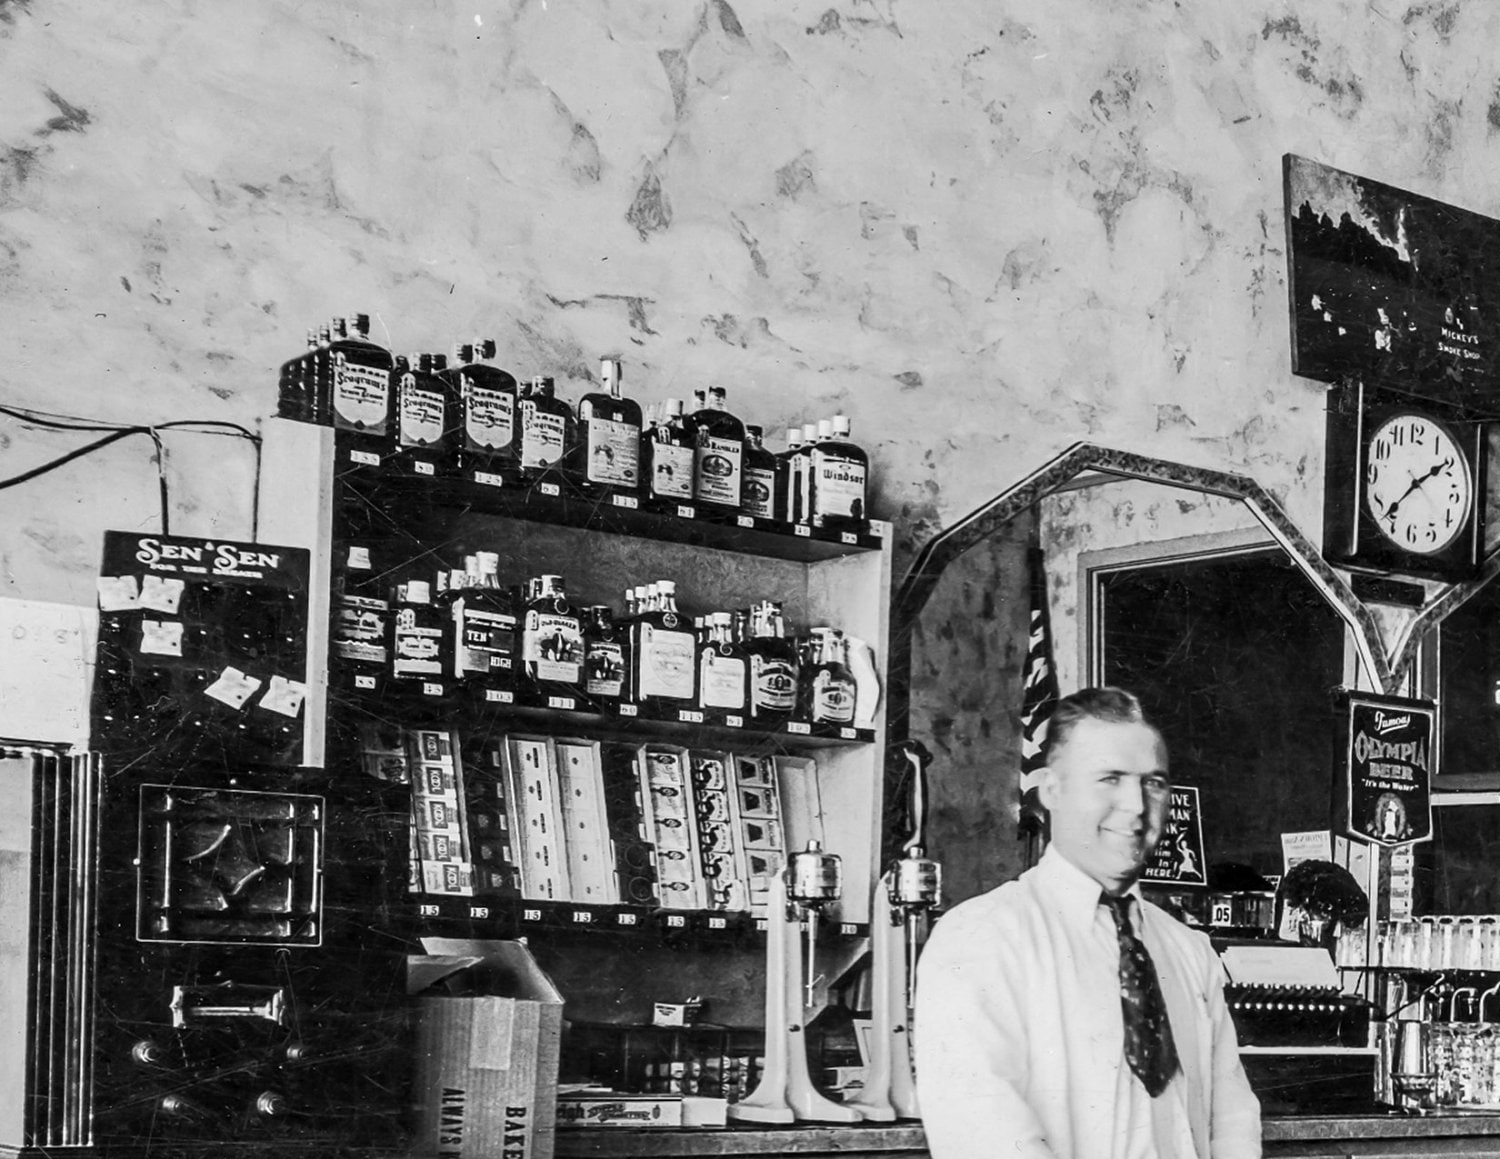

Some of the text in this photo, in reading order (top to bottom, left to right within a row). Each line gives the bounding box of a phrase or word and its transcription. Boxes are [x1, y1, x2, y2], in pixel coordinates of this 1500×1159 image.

[1410, 423, 1424, 446] 12
[1376, 439, 1390, 460] 10
[823, 468, 864, 485] Windsor
[1368, 463, 1378, 485] 9
[1406, 523, 1416, 544] 6
[214, 545, 280, 570] SEN
[466, 630, 487, 642] TEN
[490, 656, 512, 669] HIGH
[1374, 710, 1411, 734] Famous
[1354, 730, 1427, 772] OLYMPIA
[1368, 761, 1414, 781] BEER
[422, 905, 438, 916] 15
[471, 908, 488, 918] 15
[525, 910, 540, 920] 15
[574, 913, 590, 922] 15
[619, 915, 635, 924] 15
[669, 916, 684, 926] 15
[440, 1088, 466, 1145] ALWAYS
